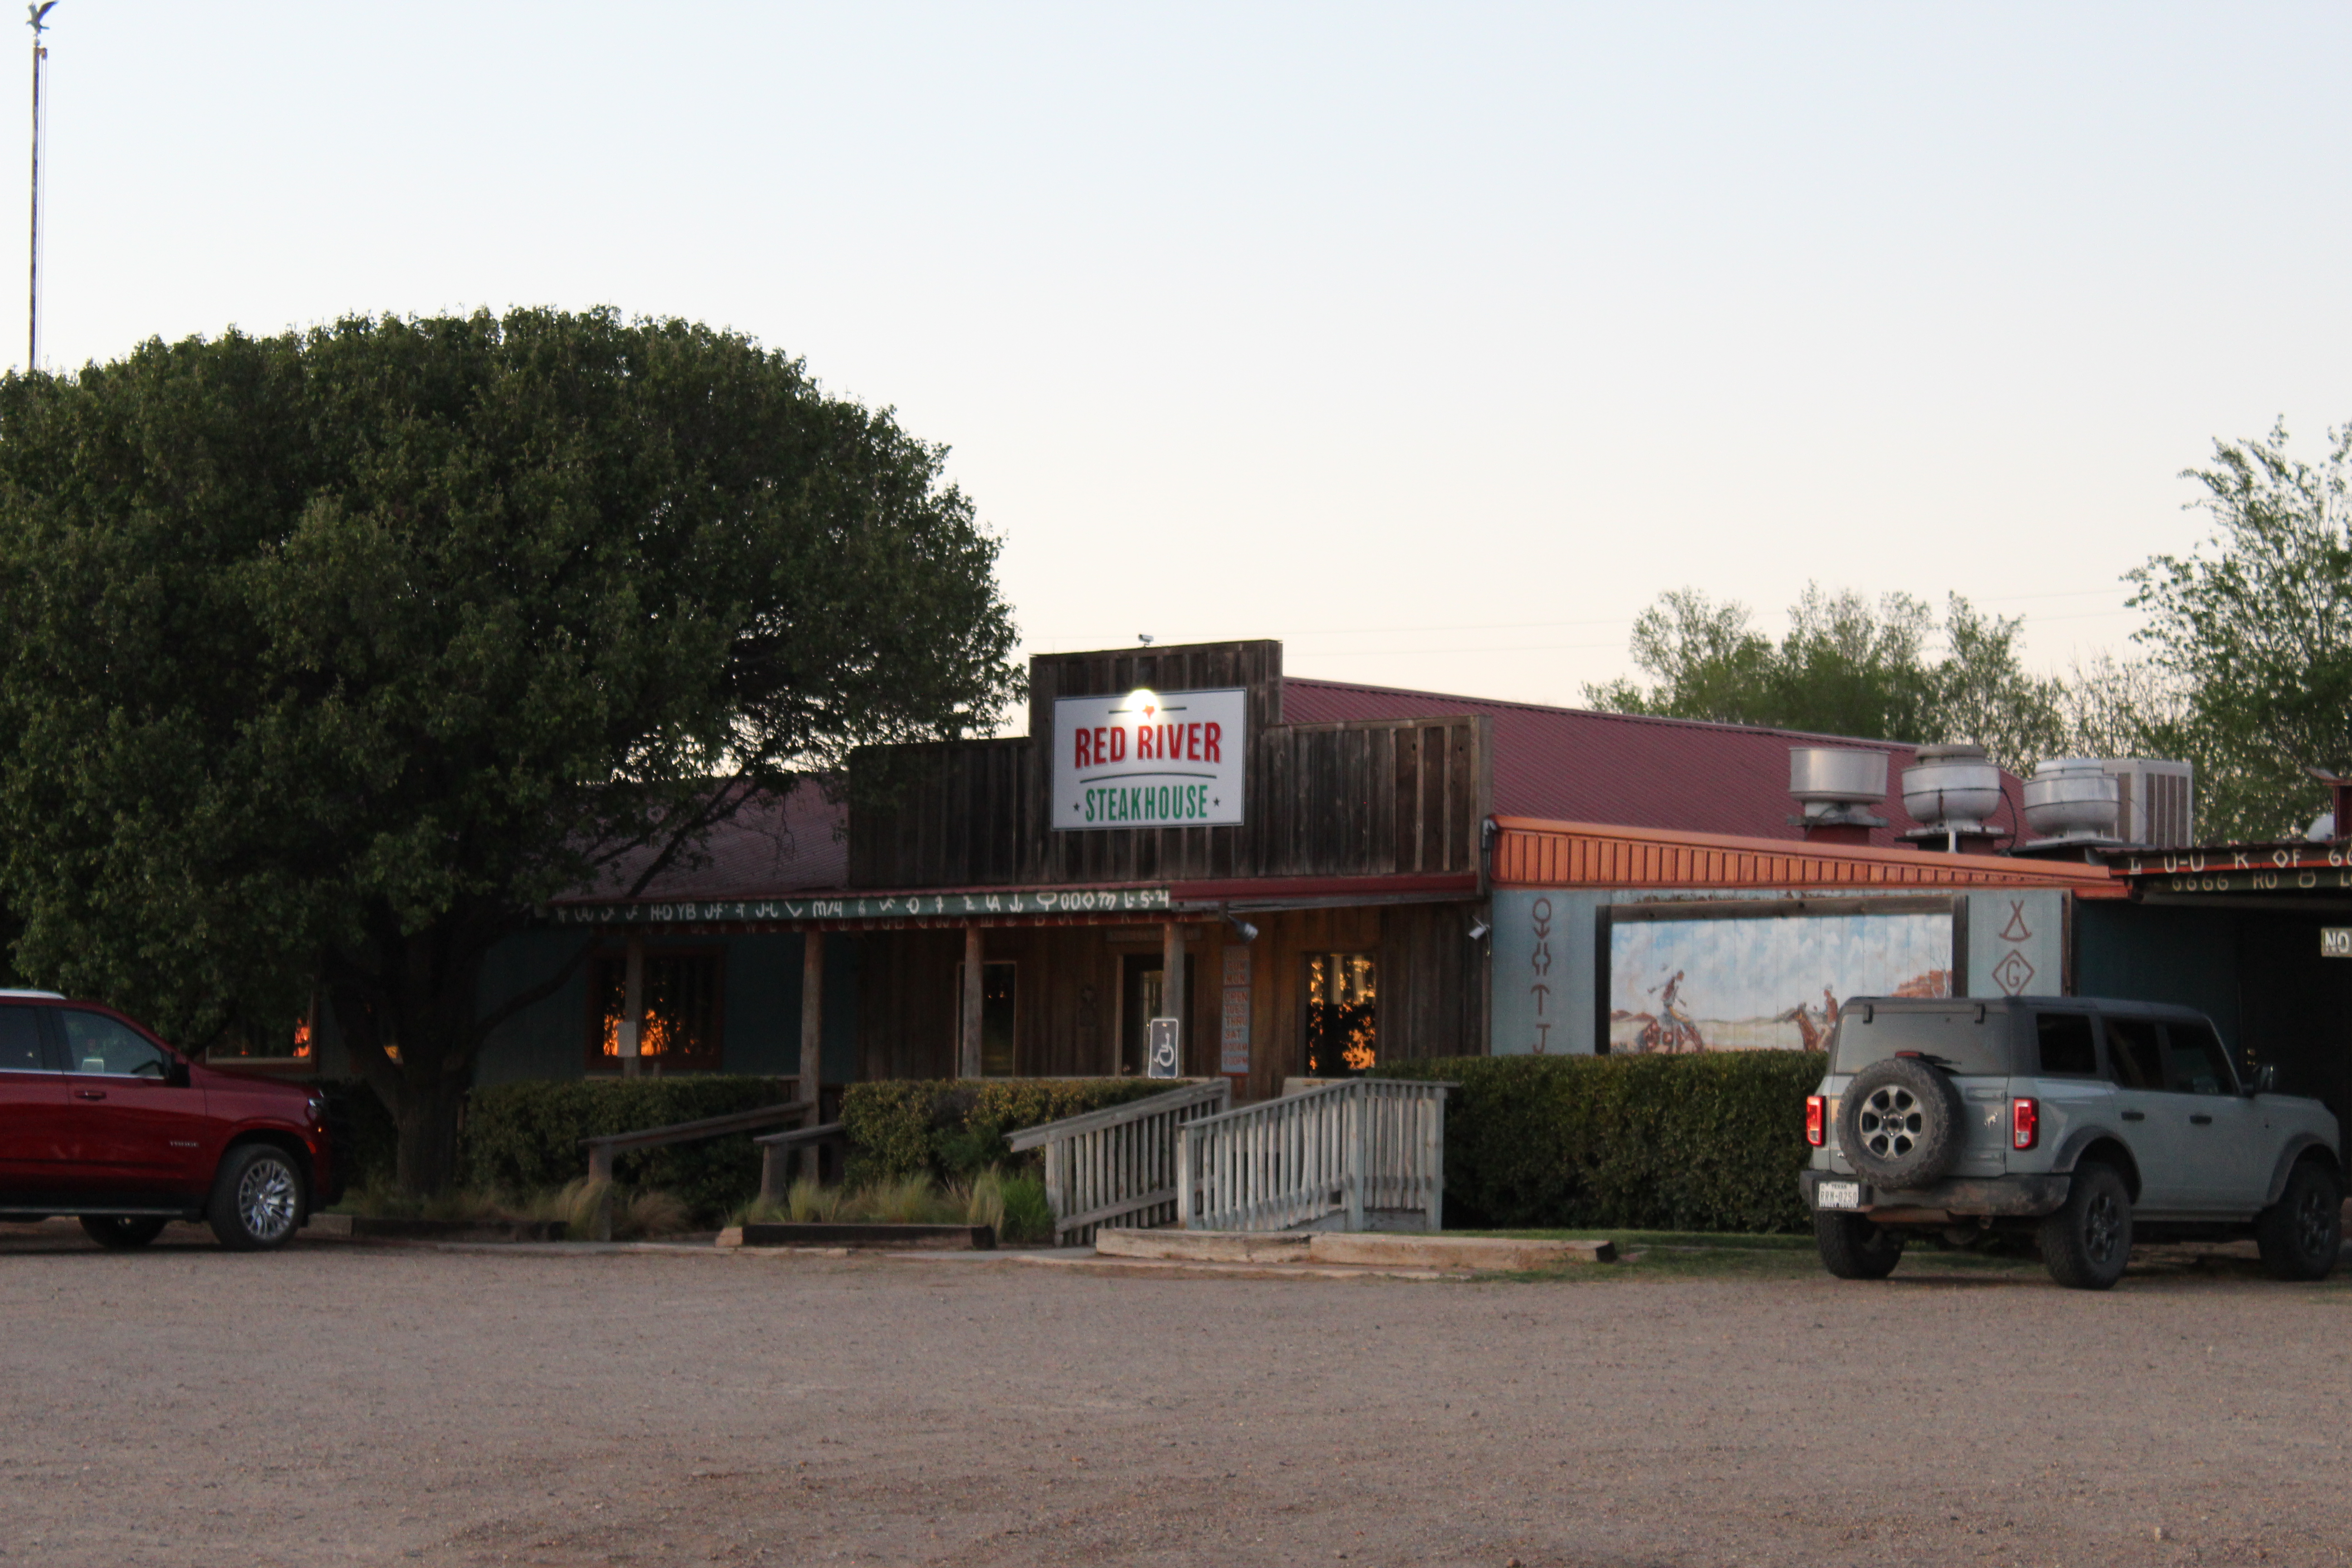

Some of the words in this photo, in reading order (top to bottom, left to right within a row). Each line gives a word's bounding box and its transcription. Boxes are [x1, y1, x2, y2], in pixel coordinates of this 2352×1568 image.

[1074, 727, 1126, 770] RED
[1137, 722, 1222, 764] RIVER
[1085, 784, 1208, 822] STEAKHOUSE
[2325, 931, 2350, 954] NO
[1224, 991, 1248, 1003] OPEN
[1225, 1016, 1248, 1027] THRU
